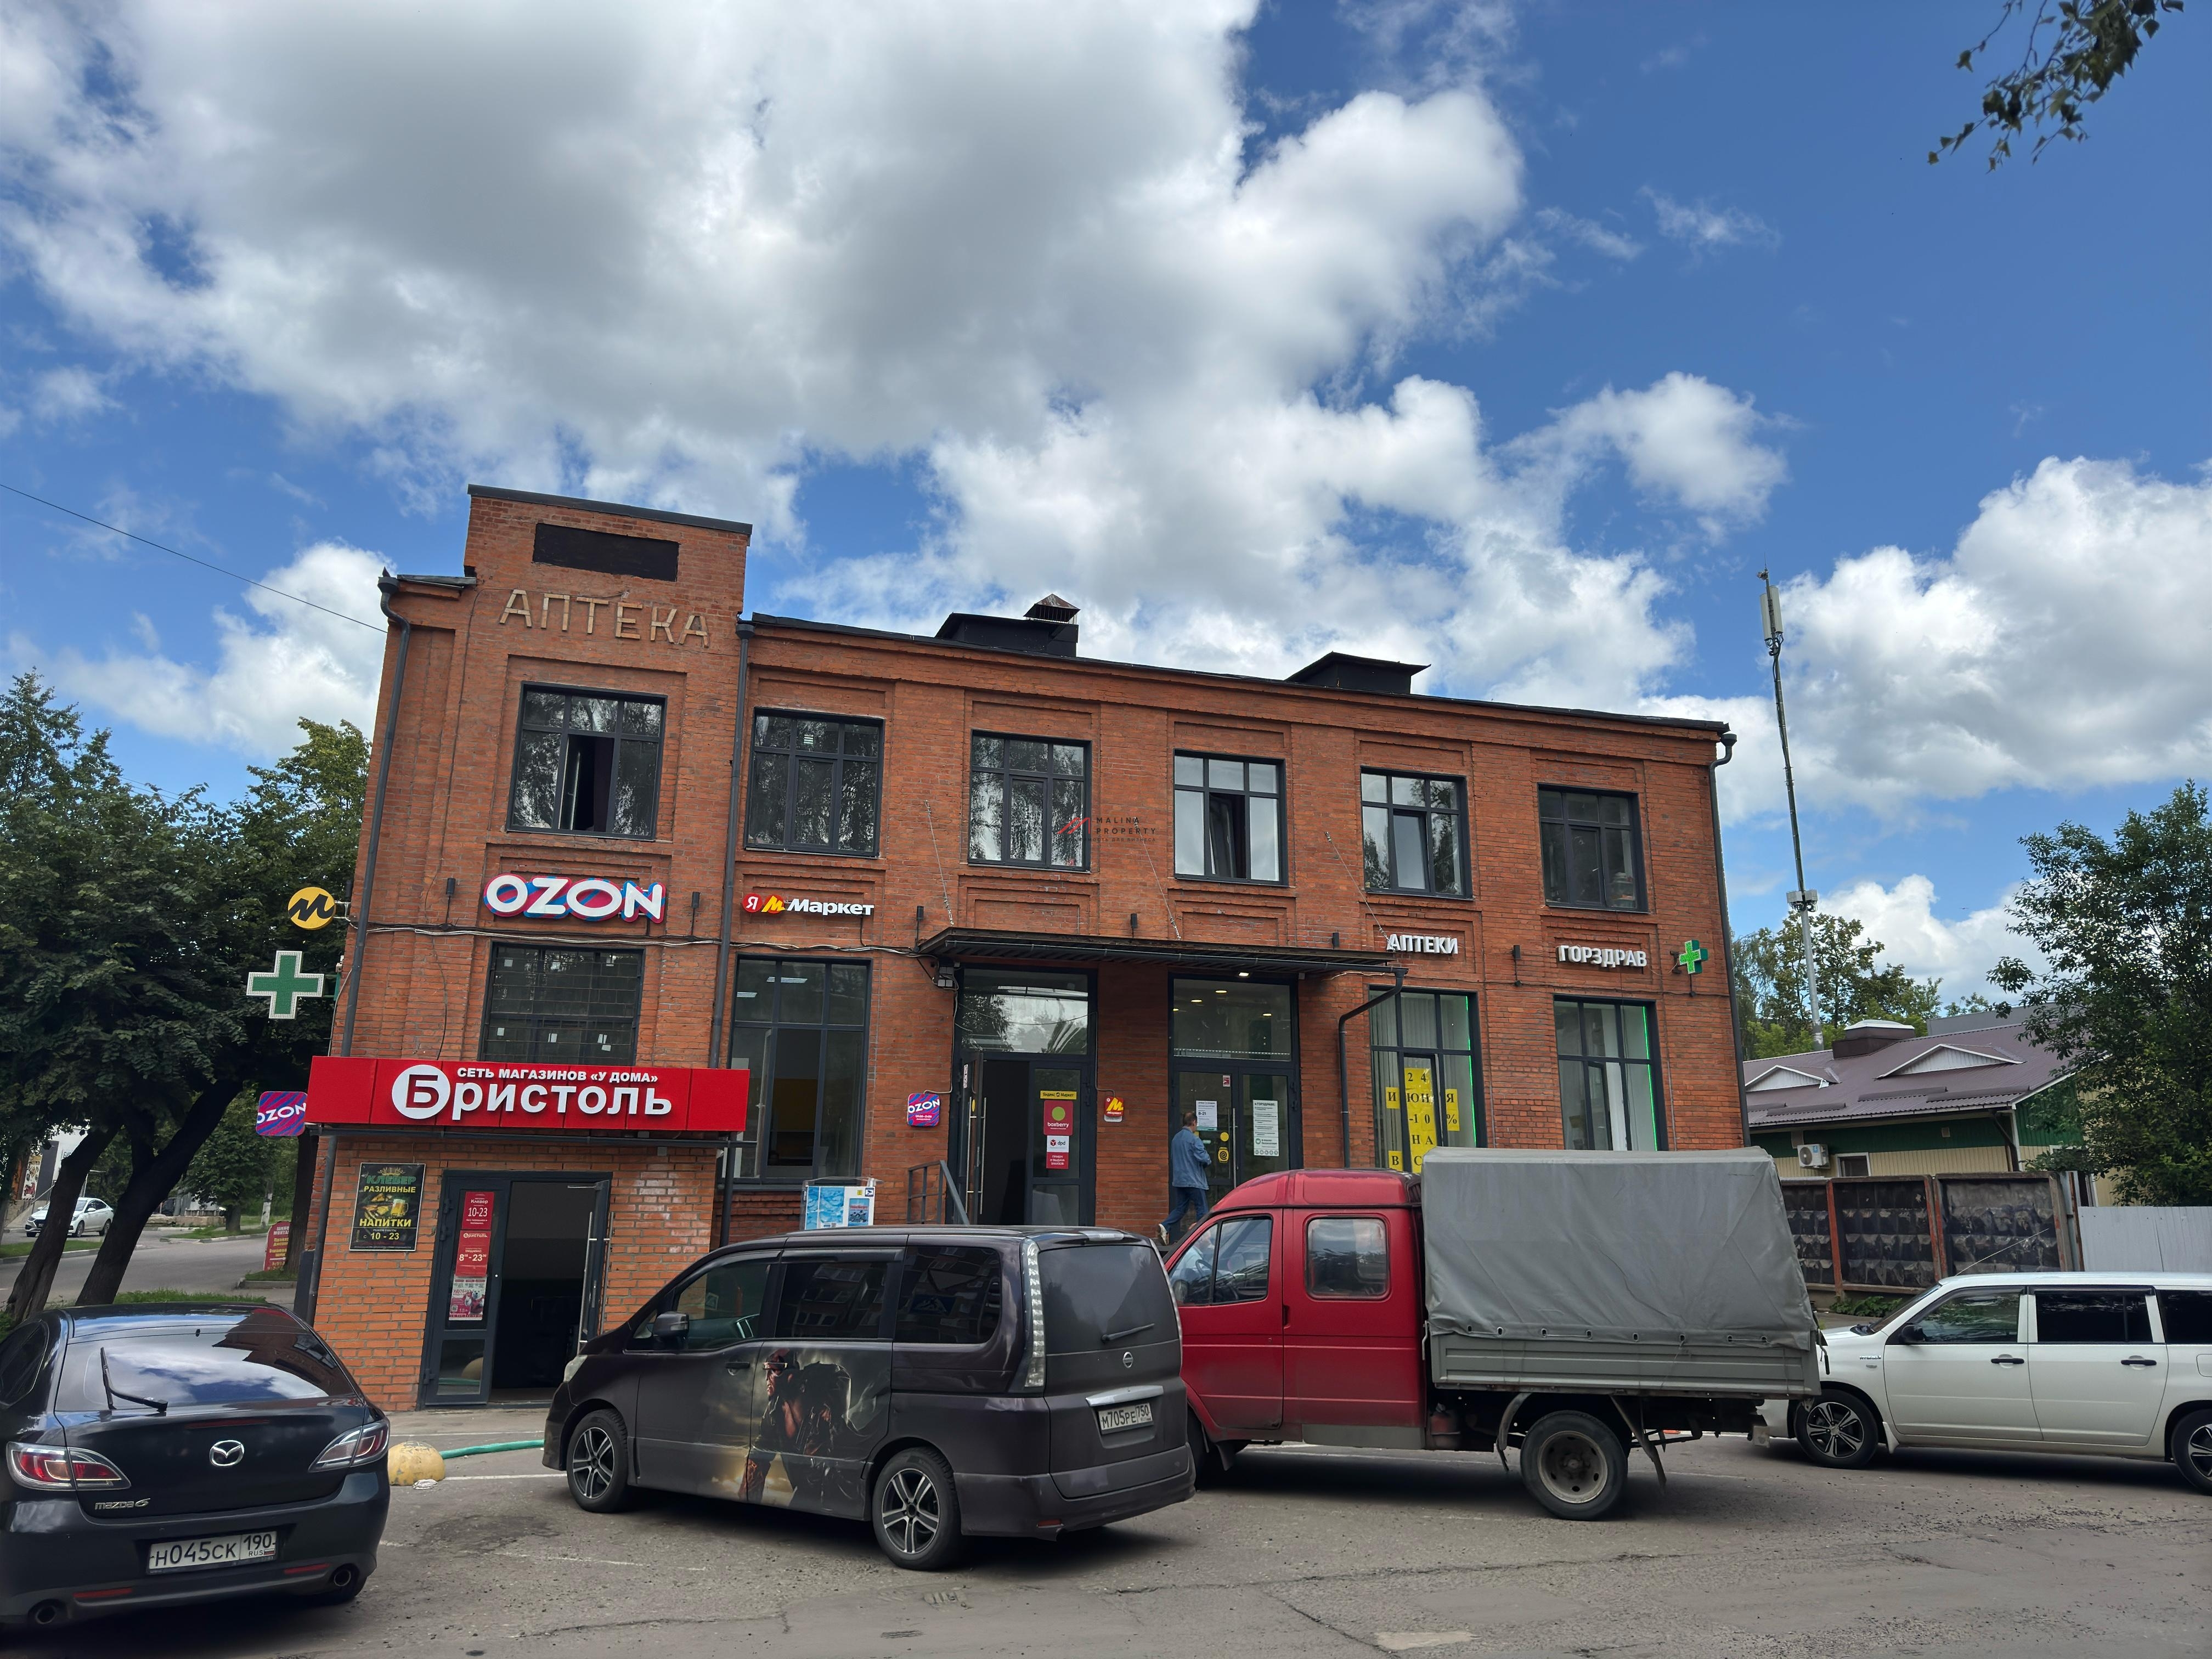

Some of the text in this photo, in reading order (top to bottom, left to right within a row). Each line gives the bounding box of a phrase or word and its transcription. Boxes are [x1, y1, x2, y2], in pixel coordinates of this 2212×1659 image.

[499, 589, 709, 648] АПТЕКА
[486, 874, 663, 919] OZON
[787, 898, 874, 916] Маркет
[1386, 933, 1458, 955] АПТЕКИ
[1558, 944, 1647, 968] ГОРЗДРАВ
[457, 1067, 658, 1084] СЕТЬ МАГАЗИНОВ «У ДОМА»
[406, 1074, 672, 1120] Бристоль
[908, 1099, 940, 1113] OZON
[1412, 1135, 1434, 1145] НА
[1392, 1155, 1422, 1165] ВС
[366, 1175, 416, 1184] КЛЕВЕР
[468, 1207, 488, 1217] 10-23
[359, 1218, 411, 1227] НАПИТКИ
[1102, 1410, 1136, 1429] М705РЕ
[1137, 1404, 1149, 1418] 750
[243, 1533, 272, 1550] 190
[155, 1541, 236, 1567] Н045СК
